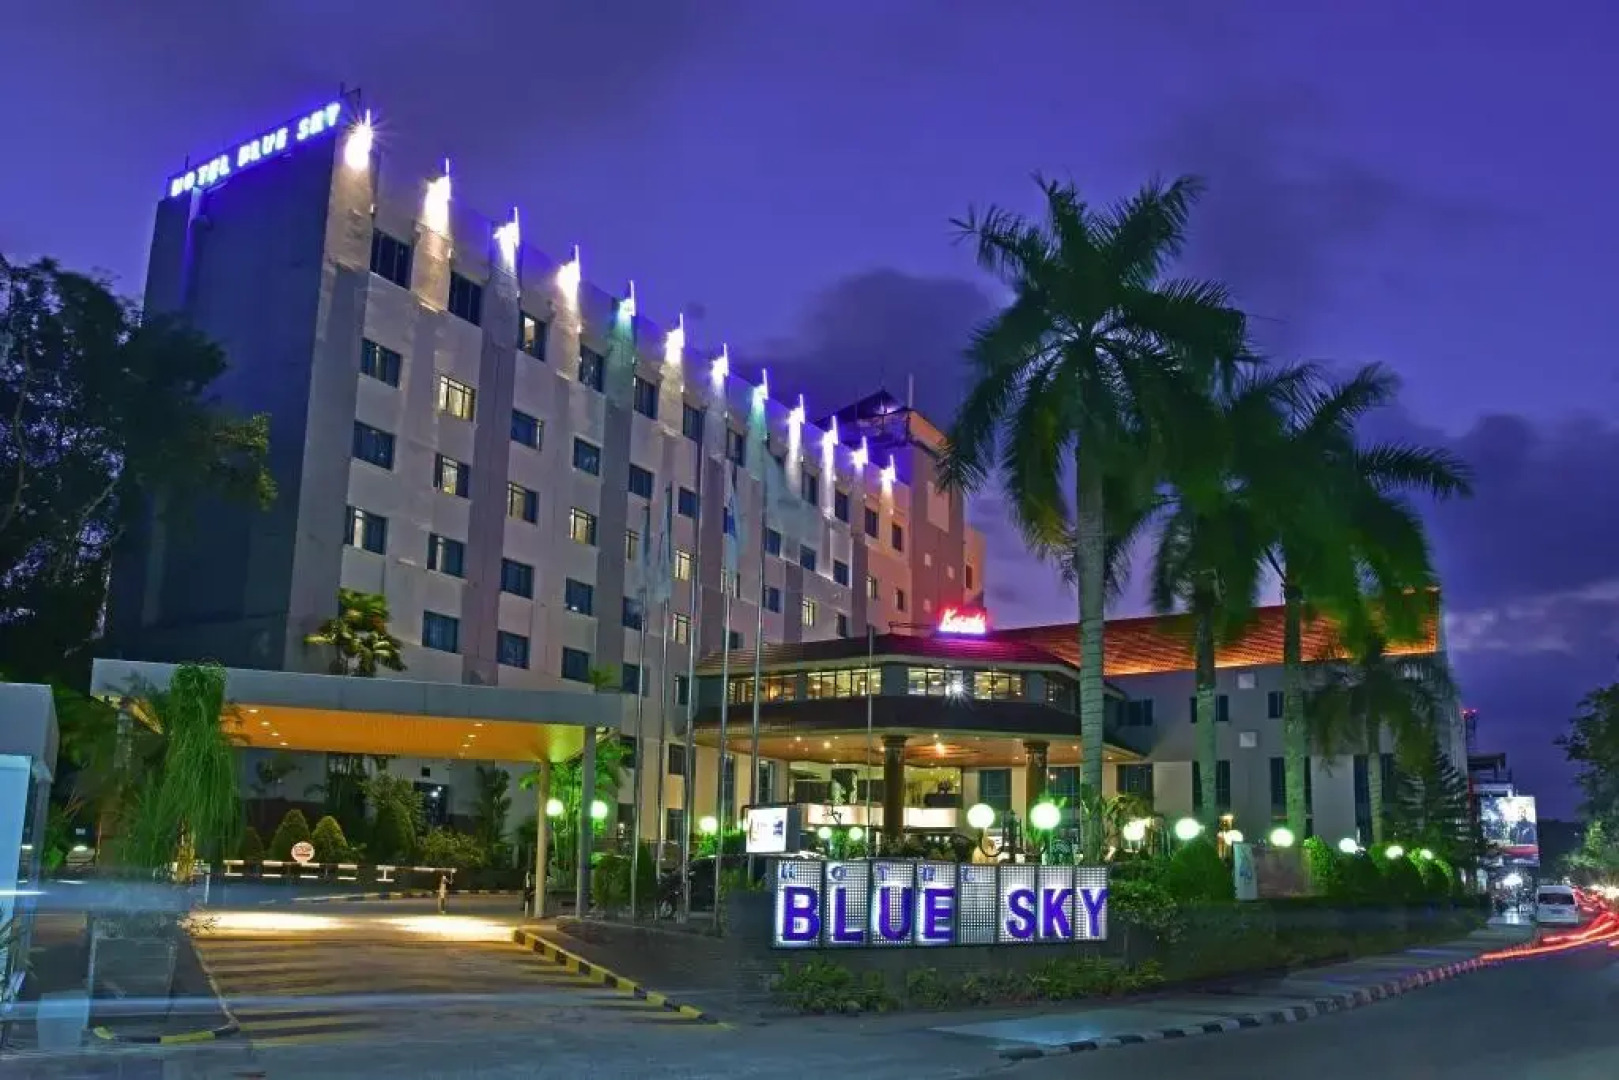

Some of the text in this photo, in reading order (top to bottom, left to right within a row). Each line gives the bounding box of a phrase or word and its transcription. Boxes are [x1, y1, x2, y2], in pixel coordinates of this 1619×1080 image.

[170, 102, 341, 197] HOTEL BLUE SKY
[780, 864, 974, 883] HOTEL
[782, 885, 1109, 941] BLUE SKY
